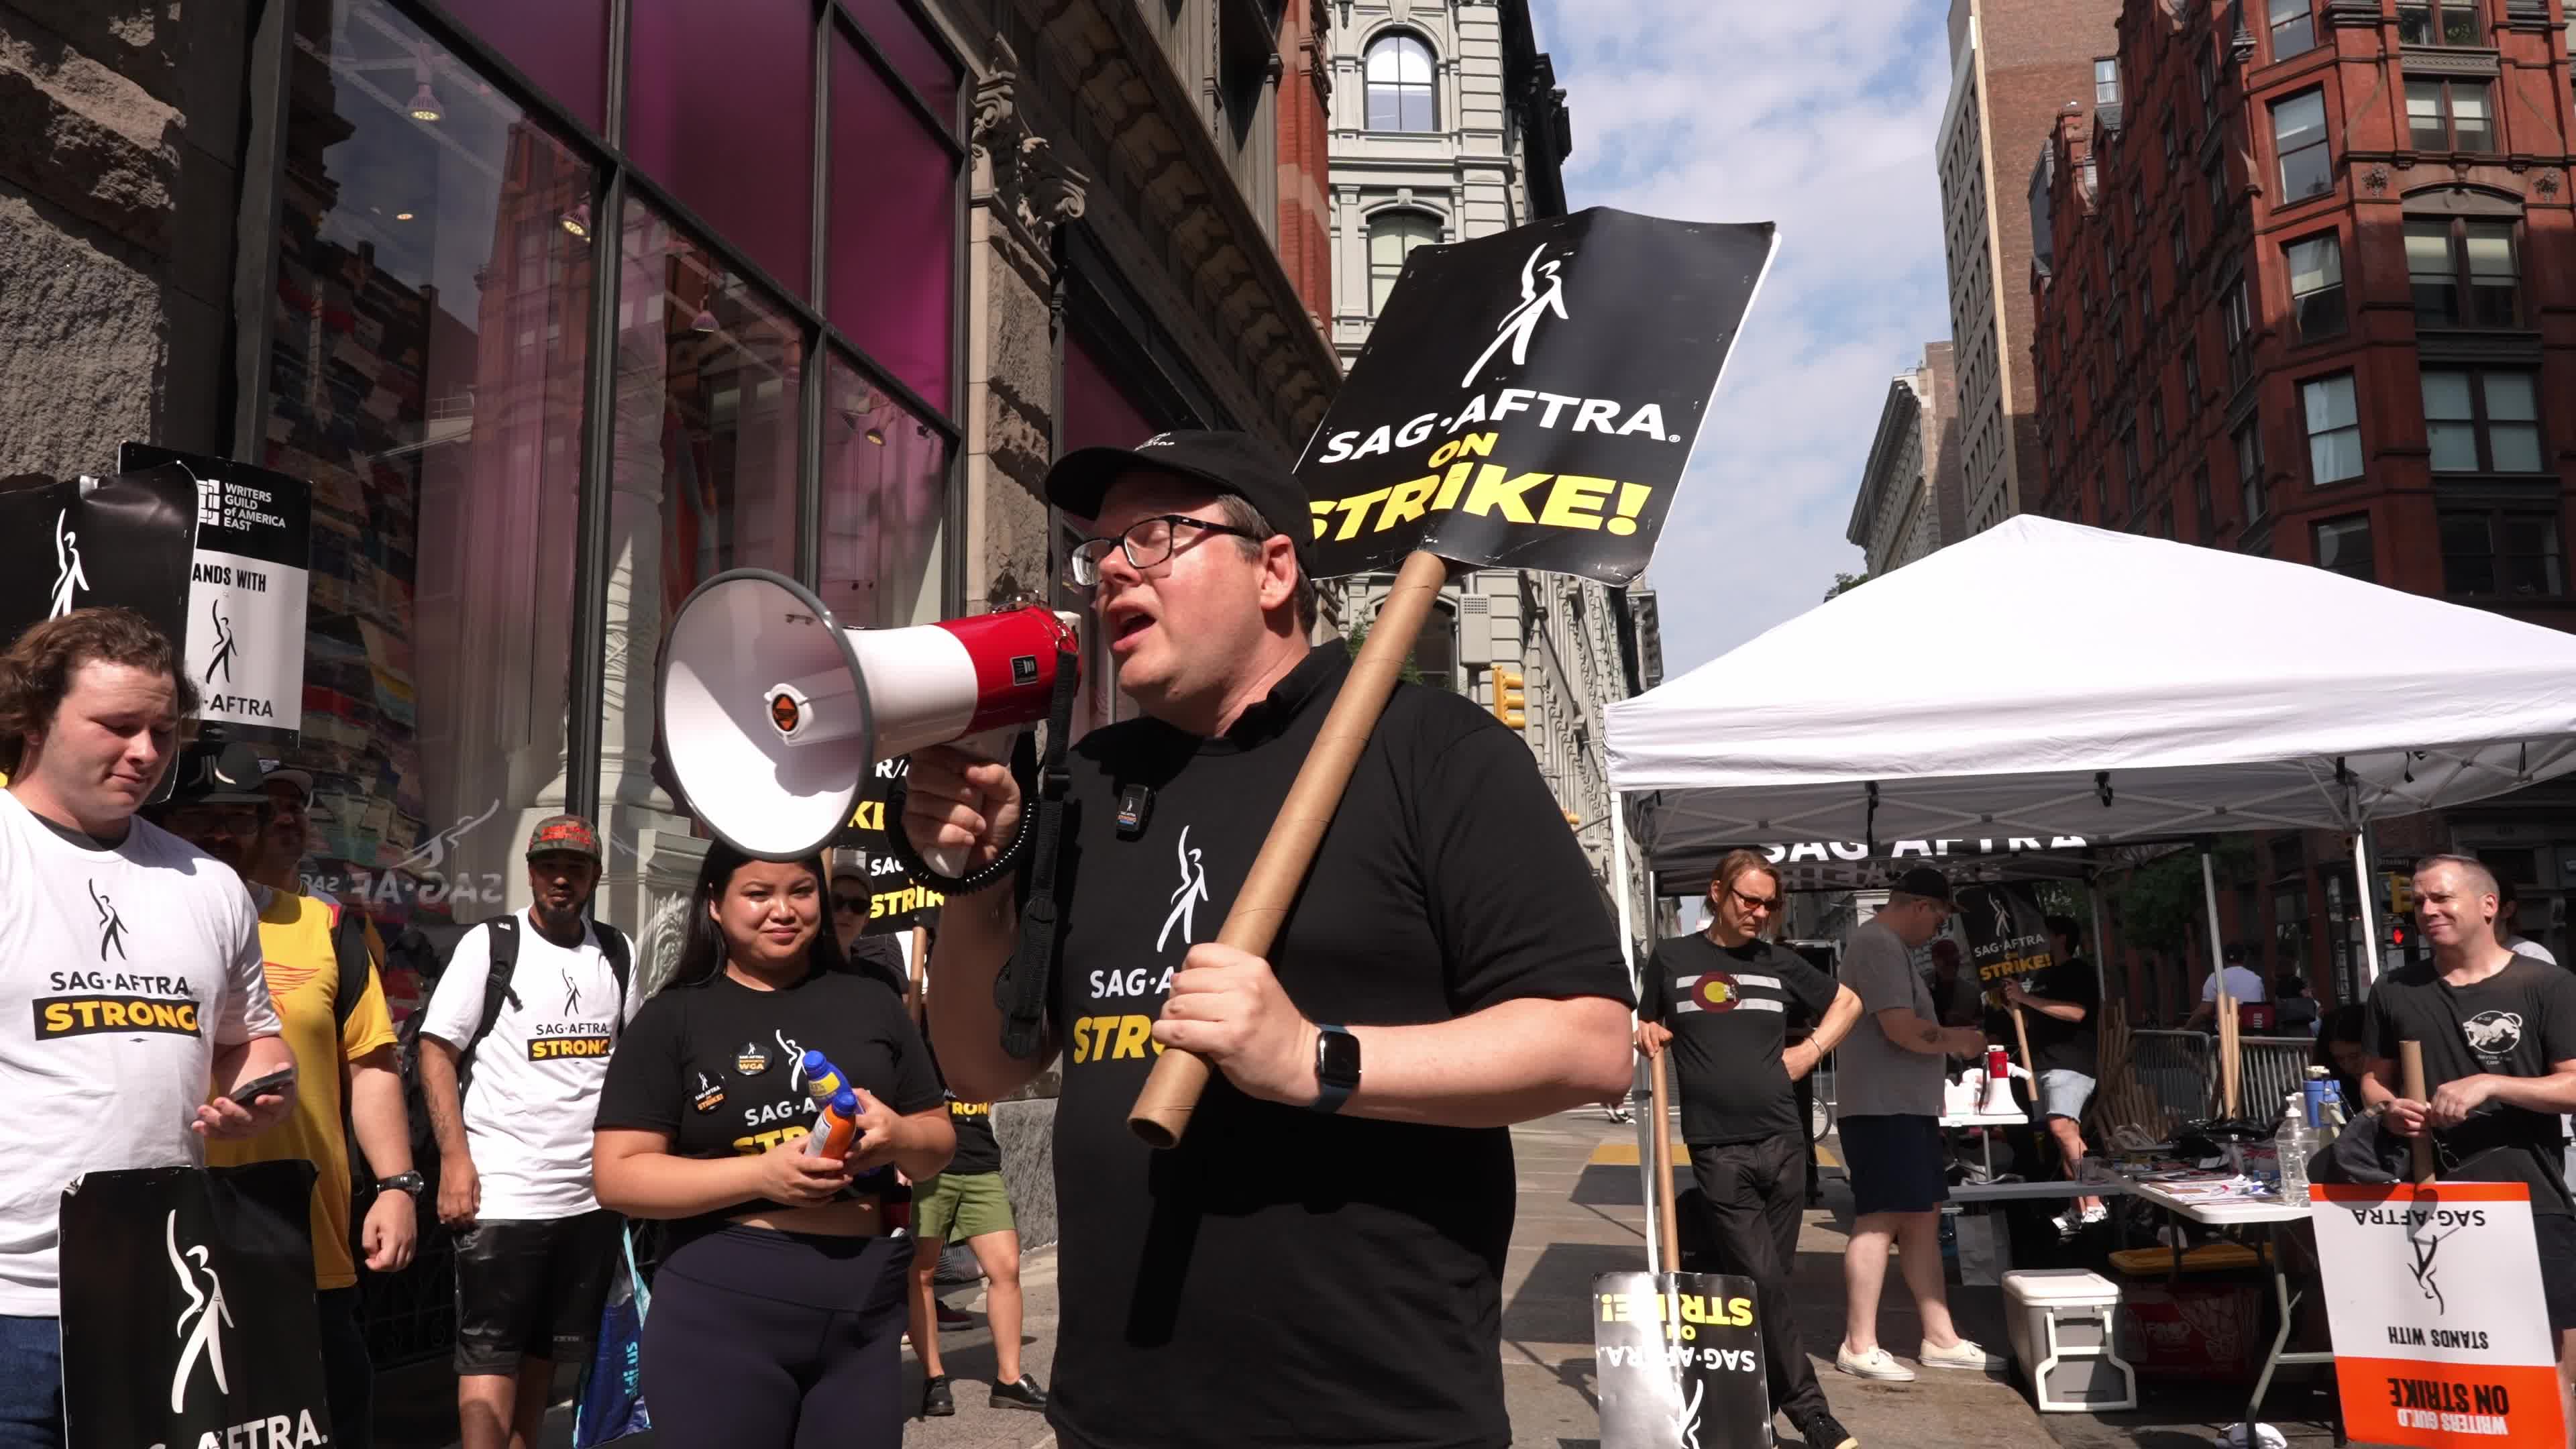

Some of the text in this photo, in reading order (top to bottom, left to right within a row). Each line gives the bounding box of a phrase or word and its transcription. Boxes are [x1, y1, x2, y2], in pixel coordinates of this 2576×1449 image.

[1428, 432, 1499, 468] ON
[225, 482, 272, 503] WRITERS
[225, 494, 258, 511] GUILD
[1309, 462, 1652, 541] STRIKE!
[223, 507, 286, 529] of AMERICA
[223, 517, 252, 532] EAST
[192, 563, 266, 592] ANDS WITH
[1073, 1014, 1165, 1065] STR
[2387, 1326, 2489, 1350] STANDS WITH
[2386, 1377, 2510, 1415] ON STRIKE
[2397, 1407, 2509, 1436] WRITERS GUILD
